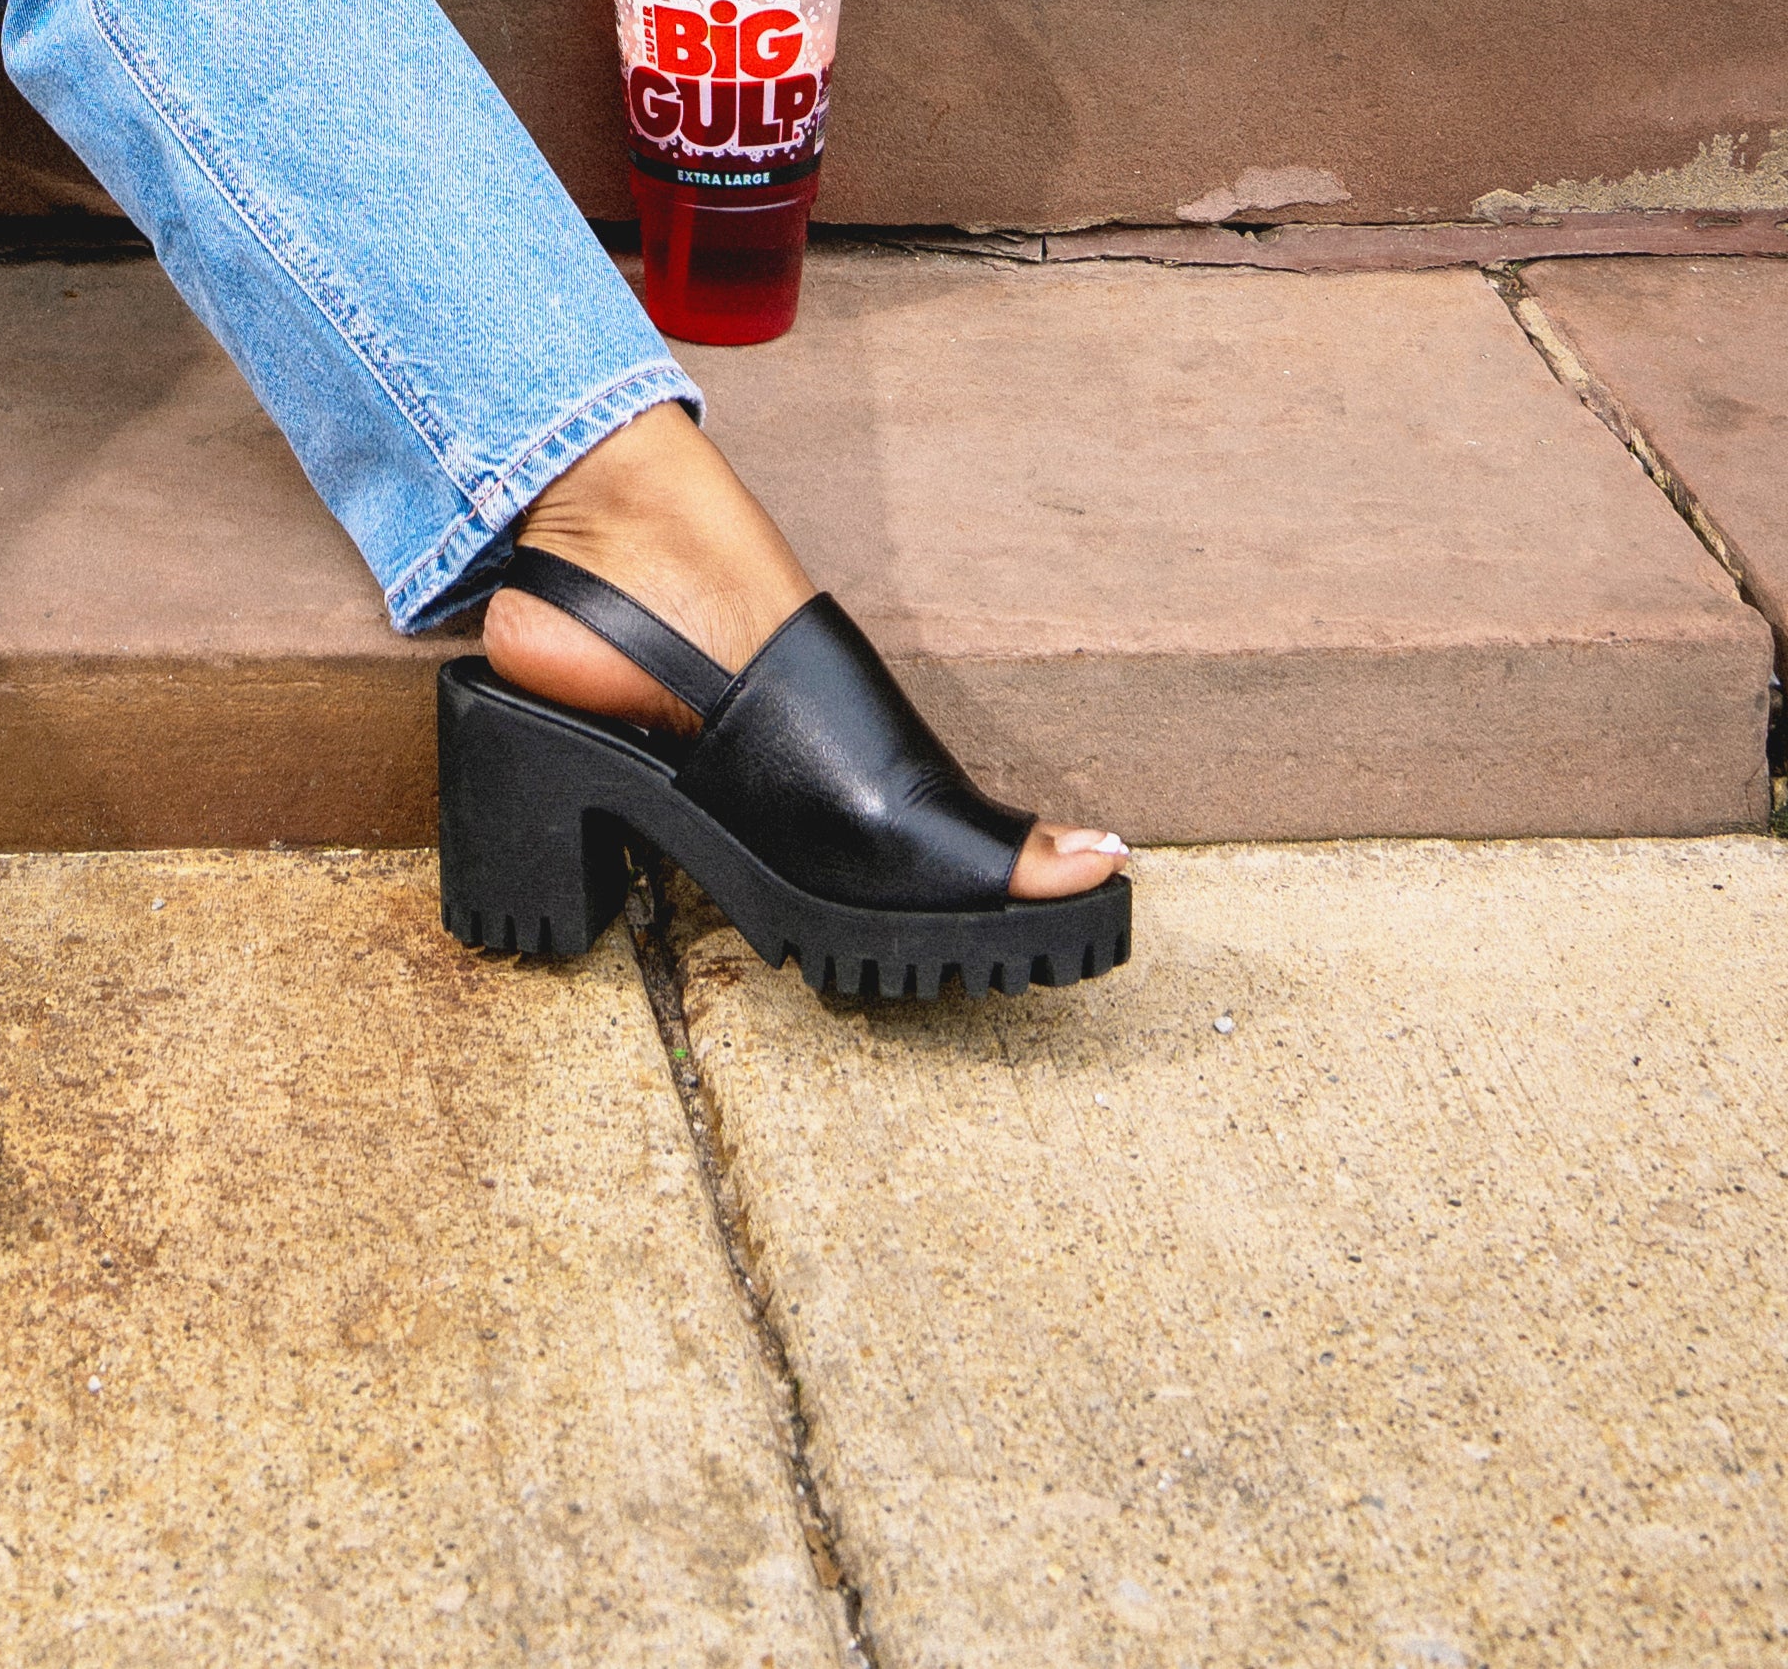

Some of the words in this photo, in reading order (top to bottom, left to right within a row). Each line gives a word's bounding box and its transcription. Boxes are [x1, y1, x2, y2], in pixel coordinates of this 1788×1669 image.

[642, 5, 657, 65] SUPER
[629, 65, 818, 147] GULP
[677, 169, 722, 186] EXTRA
[724, 171, 771, 186] LARGE
